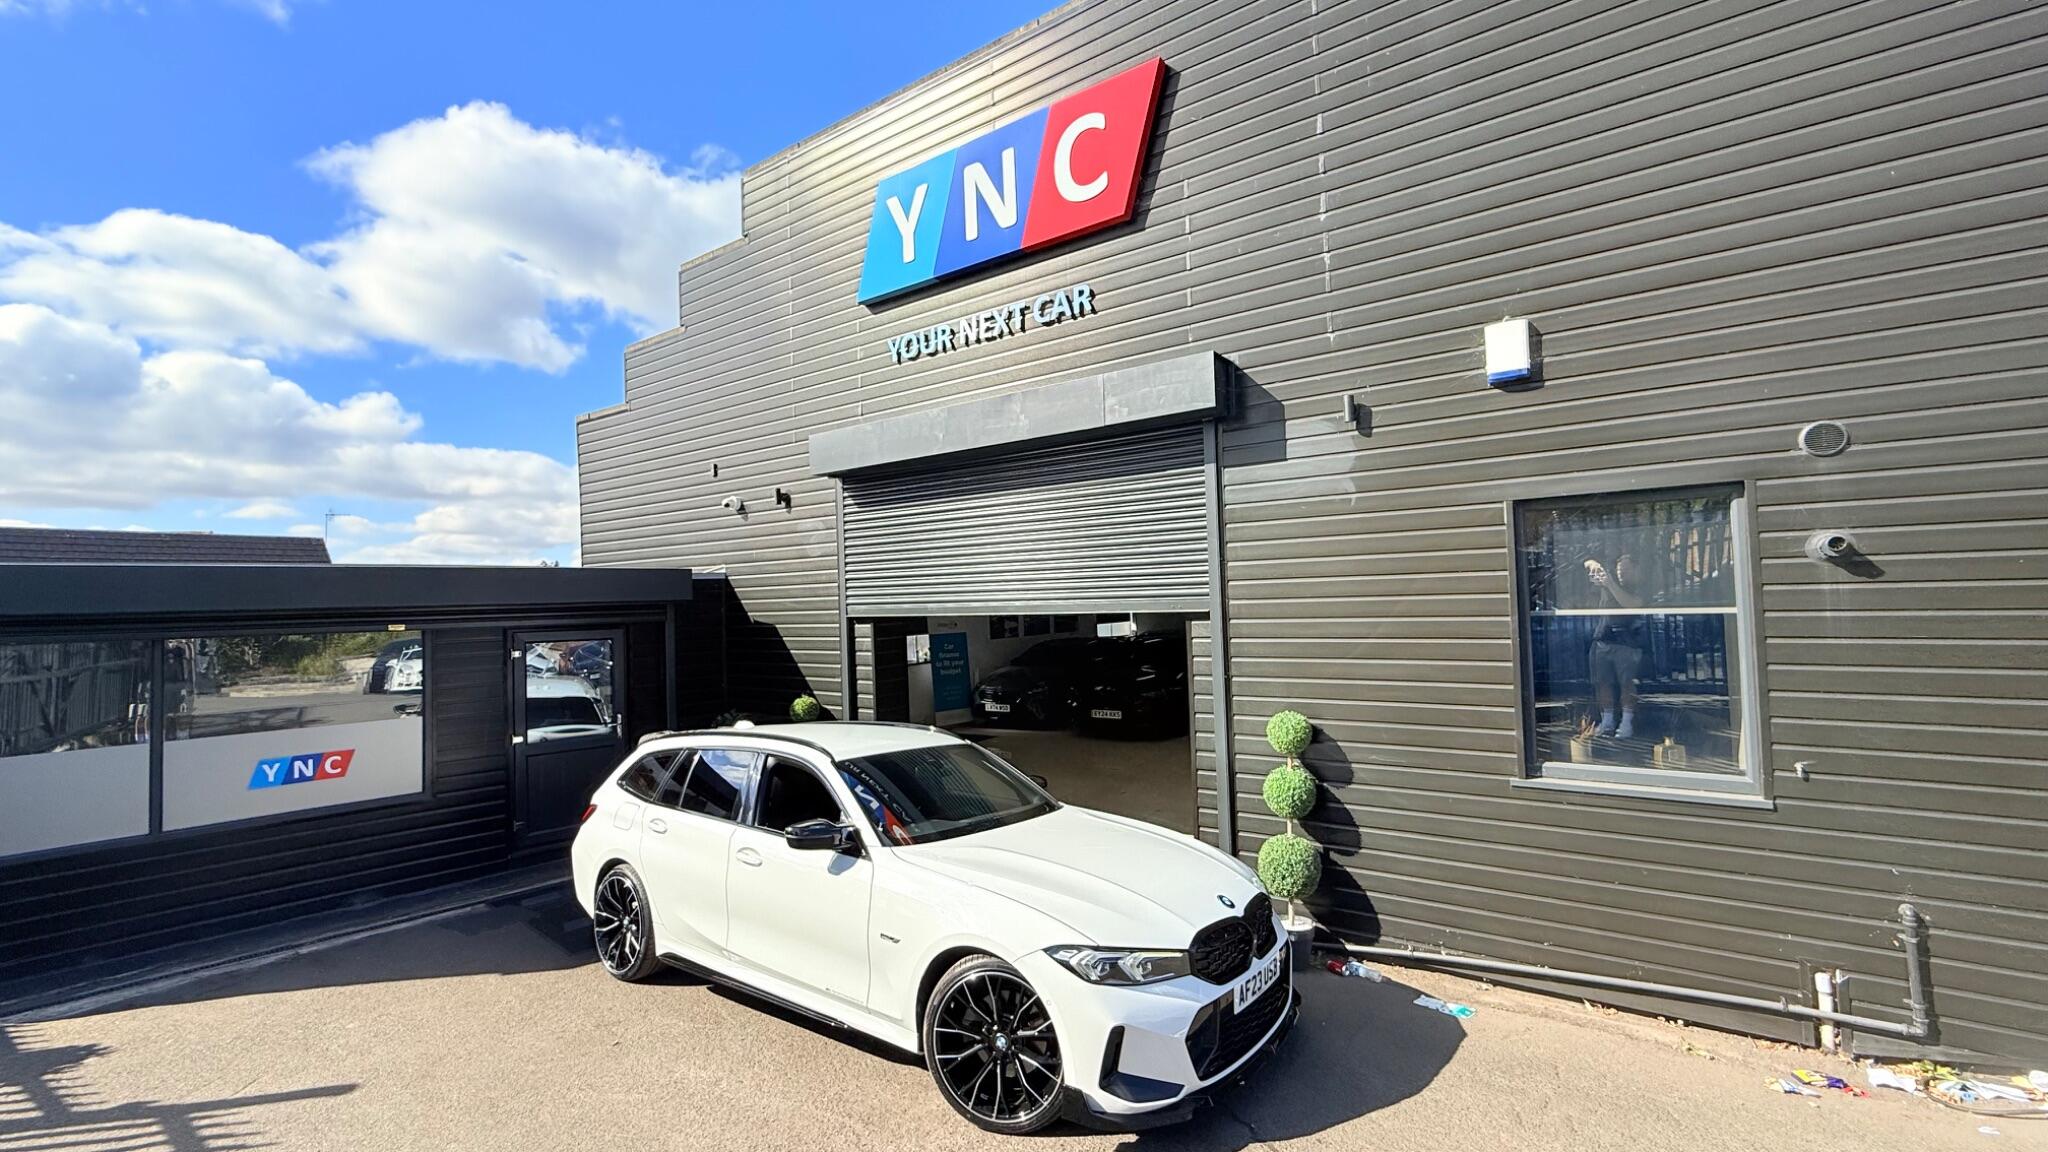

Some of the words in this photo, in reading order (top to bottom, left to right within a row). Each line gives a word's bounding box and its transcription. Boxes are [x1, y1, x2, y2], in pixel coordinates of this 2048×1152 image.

[886, 111, 1108, 264] YNC
[887, 324, 953, 364] YOUR
[959, 301, 1028, 347] NEXT
[1032, 283, 1094, 325] CAR
[261, 755, 342, 782] YNC
[1239, 970, 1262, 1006] AF23
